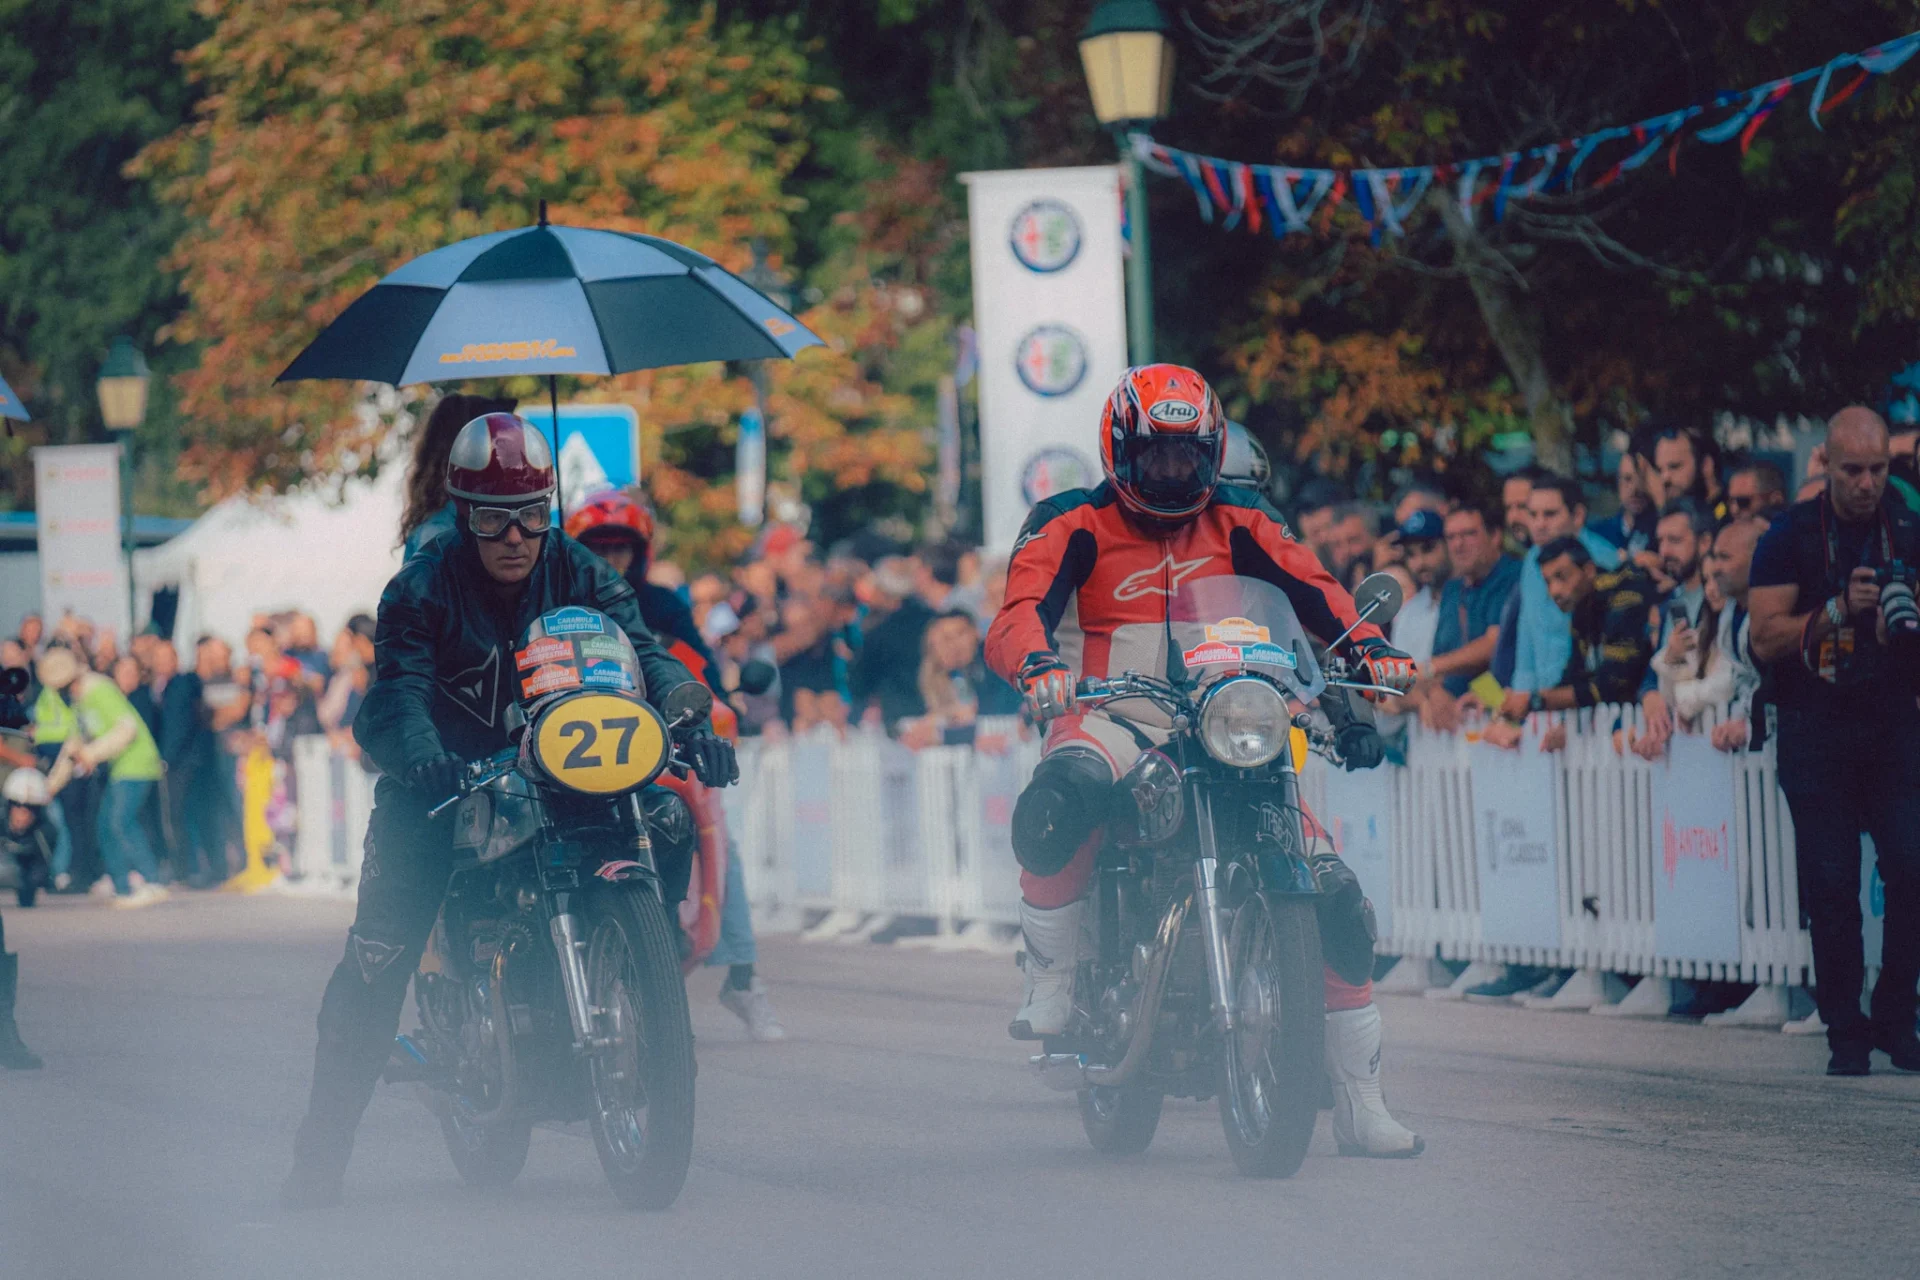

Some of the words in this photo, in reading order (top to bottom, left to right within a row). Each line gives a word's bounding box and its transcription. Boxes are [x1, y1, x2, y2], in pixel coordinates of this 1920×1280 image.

[1154, 403, 1193, 416] Arai
[557, 616, 594, 624] CARAMULO
[549, 624, 601, 632] MOTORFESTIVAL
[559, 716, 640, 770] 27
